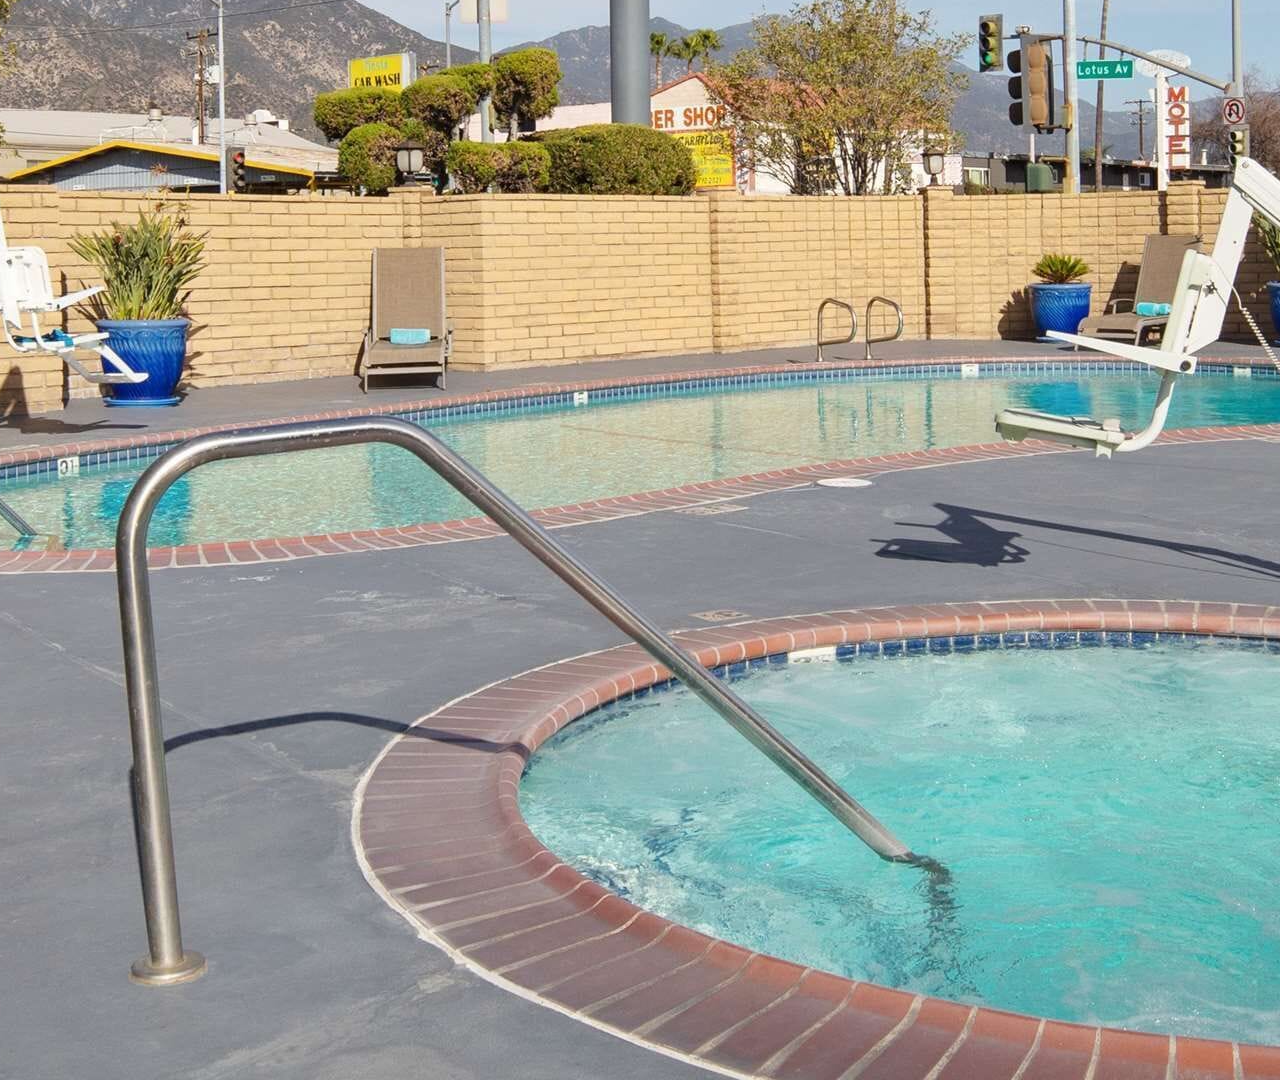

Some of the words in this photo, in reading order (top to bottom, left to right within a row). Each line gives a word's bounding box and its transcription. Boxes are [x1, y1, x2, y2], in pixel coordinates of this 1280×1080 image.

[354, 76, 372, 87] CAR
[375, 72, 401, 87] WASH
[1078, 65, 1109, 76] Lotus
[1115, 64, 1128, 74] Av
[683, 104, 727, 127] SHOP
[1167, 86, 1186, 170] MOTEL
